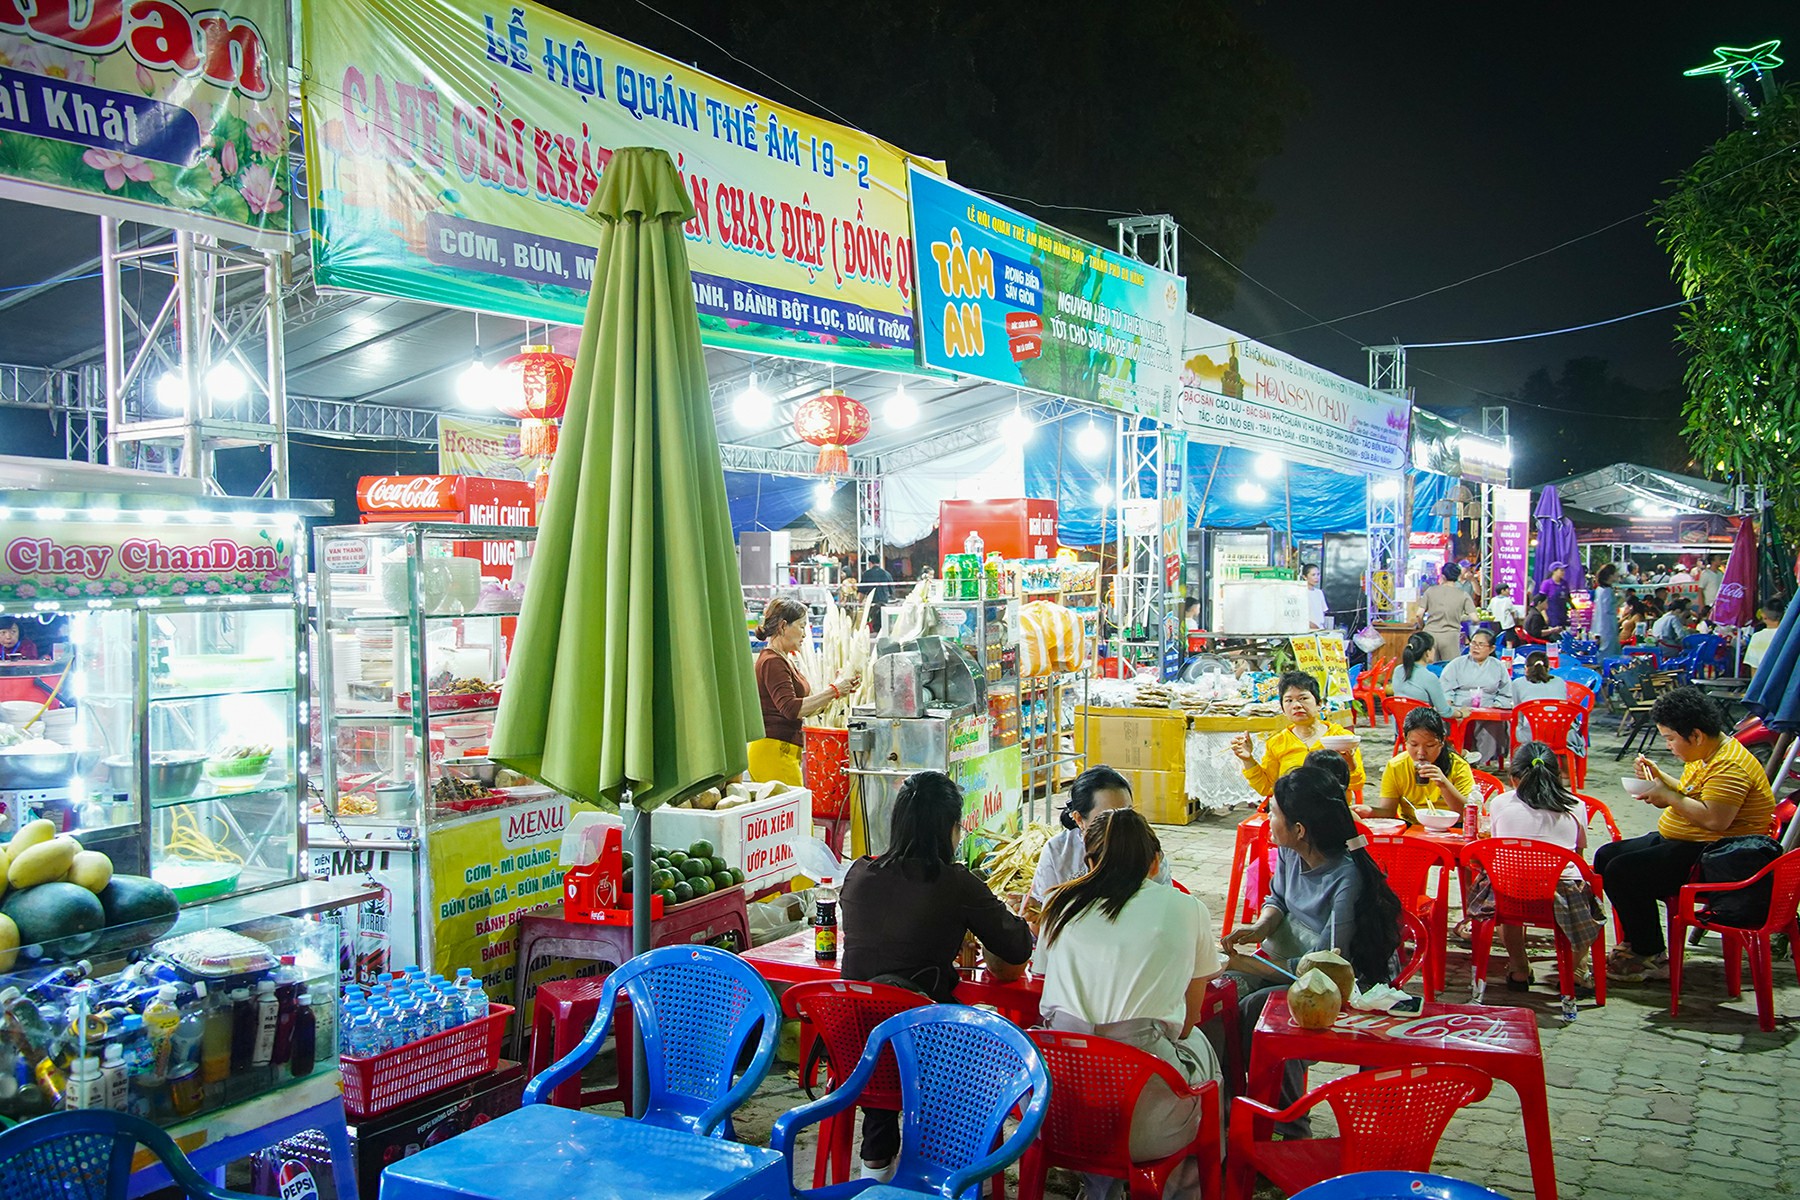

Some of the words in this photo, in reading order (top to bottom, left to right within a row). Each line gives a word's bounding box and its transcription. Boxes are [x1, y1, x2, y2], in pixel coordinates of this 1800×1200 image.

[42, 86, 139, 146] Khát
[484, 8, 533, 74] LỄ
[543, 38, 606, 103] HỘI
[615, 64, 699, 131] QUÁN
[705, 97, 759, 150] THẾ
[765, 114, 800, 167] ÂM
[810, 137, 835, 178] 19
[857, 154, 870, 190] 2
[452, 82, 529, 197] GIẢI
[716, 183, 776, 257] CHAY
[780, 192, 826, 286] ĐIỆP
[843, 197, 892, 285] ĐỒNG
[440, 227, 507, 268] CƠM,
[514, 242, 570, 279] BÚN,
[576, 253, 600, 282] M
[931, 227, 996, 300] TÂM
[1004, 264, 1025, 285] RONG
[1004, 281, 1018, 301] SẤY
[733, 290, 778, 317] BÁNH
[781, 300, 810, 325] BỘT
[813, 308, 845, 332] LỌC,
[847, 311, 876, 334] BÚN
[1057, 290, 1093, 321] NGUYÊN
[1093, 302, 1111, 327] LIỆU
[943, 301, 985, 359] AN
[1050, 314, 1067, 340] TỐT
[1068, 323, 1088, 347] CHO
[1184, 390, 1201, 405] ĐẶC
[1201, 394, 1214, 407] SẢN
[1215, 398, 1230, 411] CAO
[1246, 405, 1259, 418] ĐẶC
[1259, 408, 1272, 420] SẢN
[1242, 419, 1255, 431] SEN
[366, 475, 446, 509] Coca-Cola
[469, 497, 499, 526] NGHỈ
[500, 500, 531, 527] CHÚT
[6, 538, 112, 579] Chay
[119, 538, 277, 573] ChanDan
[509, 805, 565, 839] MENU
[747, 818, 768, 842] DỪA
[770, 810, 795, 836] XIÊM
[465, 864, 492, 883] CƠM
[501, 855, 515, 874] MÌ
[517, 848, 551, 870] QUẢNG
[746, 849, 767, 873] ƯỚP
[441, 898, 466, 918] BÚN
[467, 887, 492, 911] CHẢ
[494, 884, 508, 903] CÁ
[517, 878, 539, 897] BÚN
[475, 913, 506, 936] BÁNH
[481, 941, 511, 962] BÁNH
[282, 1177, 316, 1200] PEPSI
